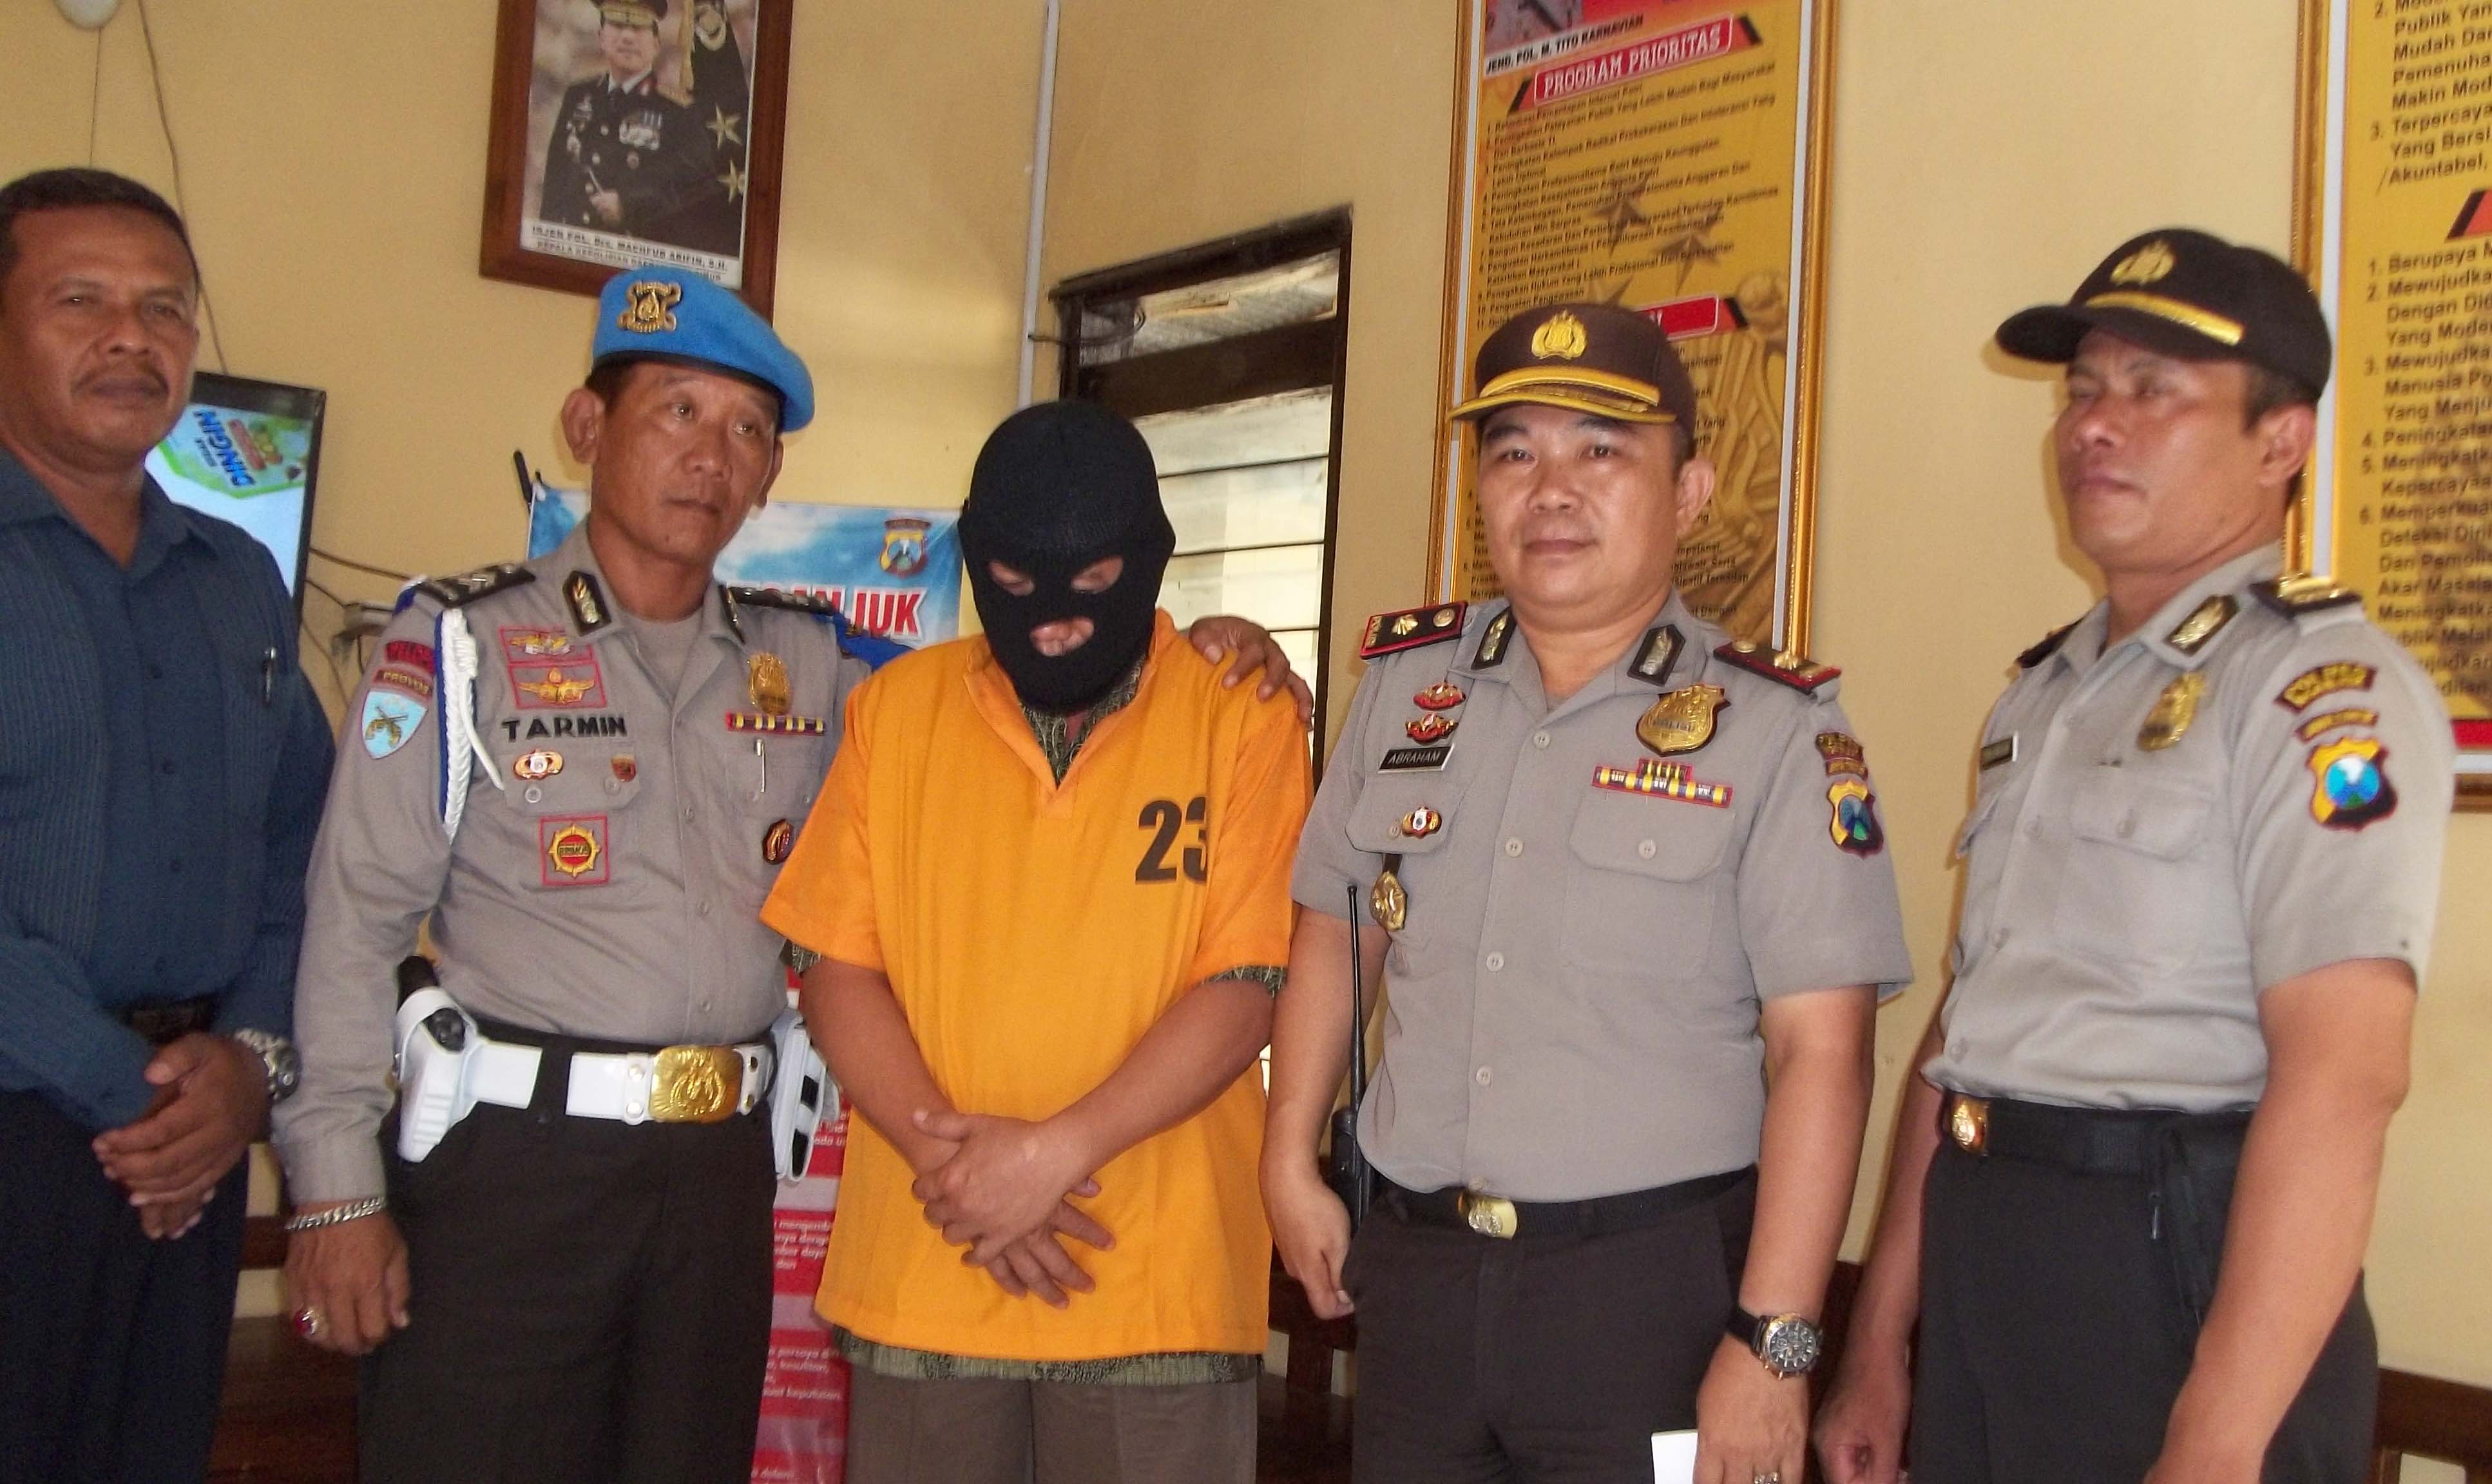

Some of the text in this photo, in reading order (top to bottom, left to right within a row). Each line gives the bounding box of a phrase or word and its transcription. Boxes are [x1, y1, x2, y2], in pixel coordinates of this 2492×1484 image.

[2395, 9, 2451, 37] Publik
[2459, 1, 2492, 20] Yan
[1555, 34, 1578, 55] TITO
[2393, 33, 2455, 62] Mudah
[1544, 23, 1721, 98] PROGRAM PRIORITAS
[2392, 53, 2492, 88] Pemenuha
[2391, 89, 2446, 112] Makin
[2391, 125, 2492, 160] Yang Bersi
[2389, 247, 2477, 274] Berupaya
[2388, 269, 2492, 298] Mewujudka
[2386, 300, 2457, 323] Dengan
[2386, 319, 2492, 347] Yang Mode
[2385, 345, 2491, 372] Mewujudka
[2385, 374, 2463, 396] Manusia
[2385, 403, 2430, 424] Yang
[193, 408, 256, 486] DINGIN
[2382, 448, 2490, 472] Meningkatk
[2381, 475, 2491, 499] Kepercayaa
[2379, 553, 2415, 573] Dan
[2427, 575, 2492, 595] Masala
[502, 716, 628, 743] TARMIN
[1387, 750, 1441, 768] ABRAHAM
